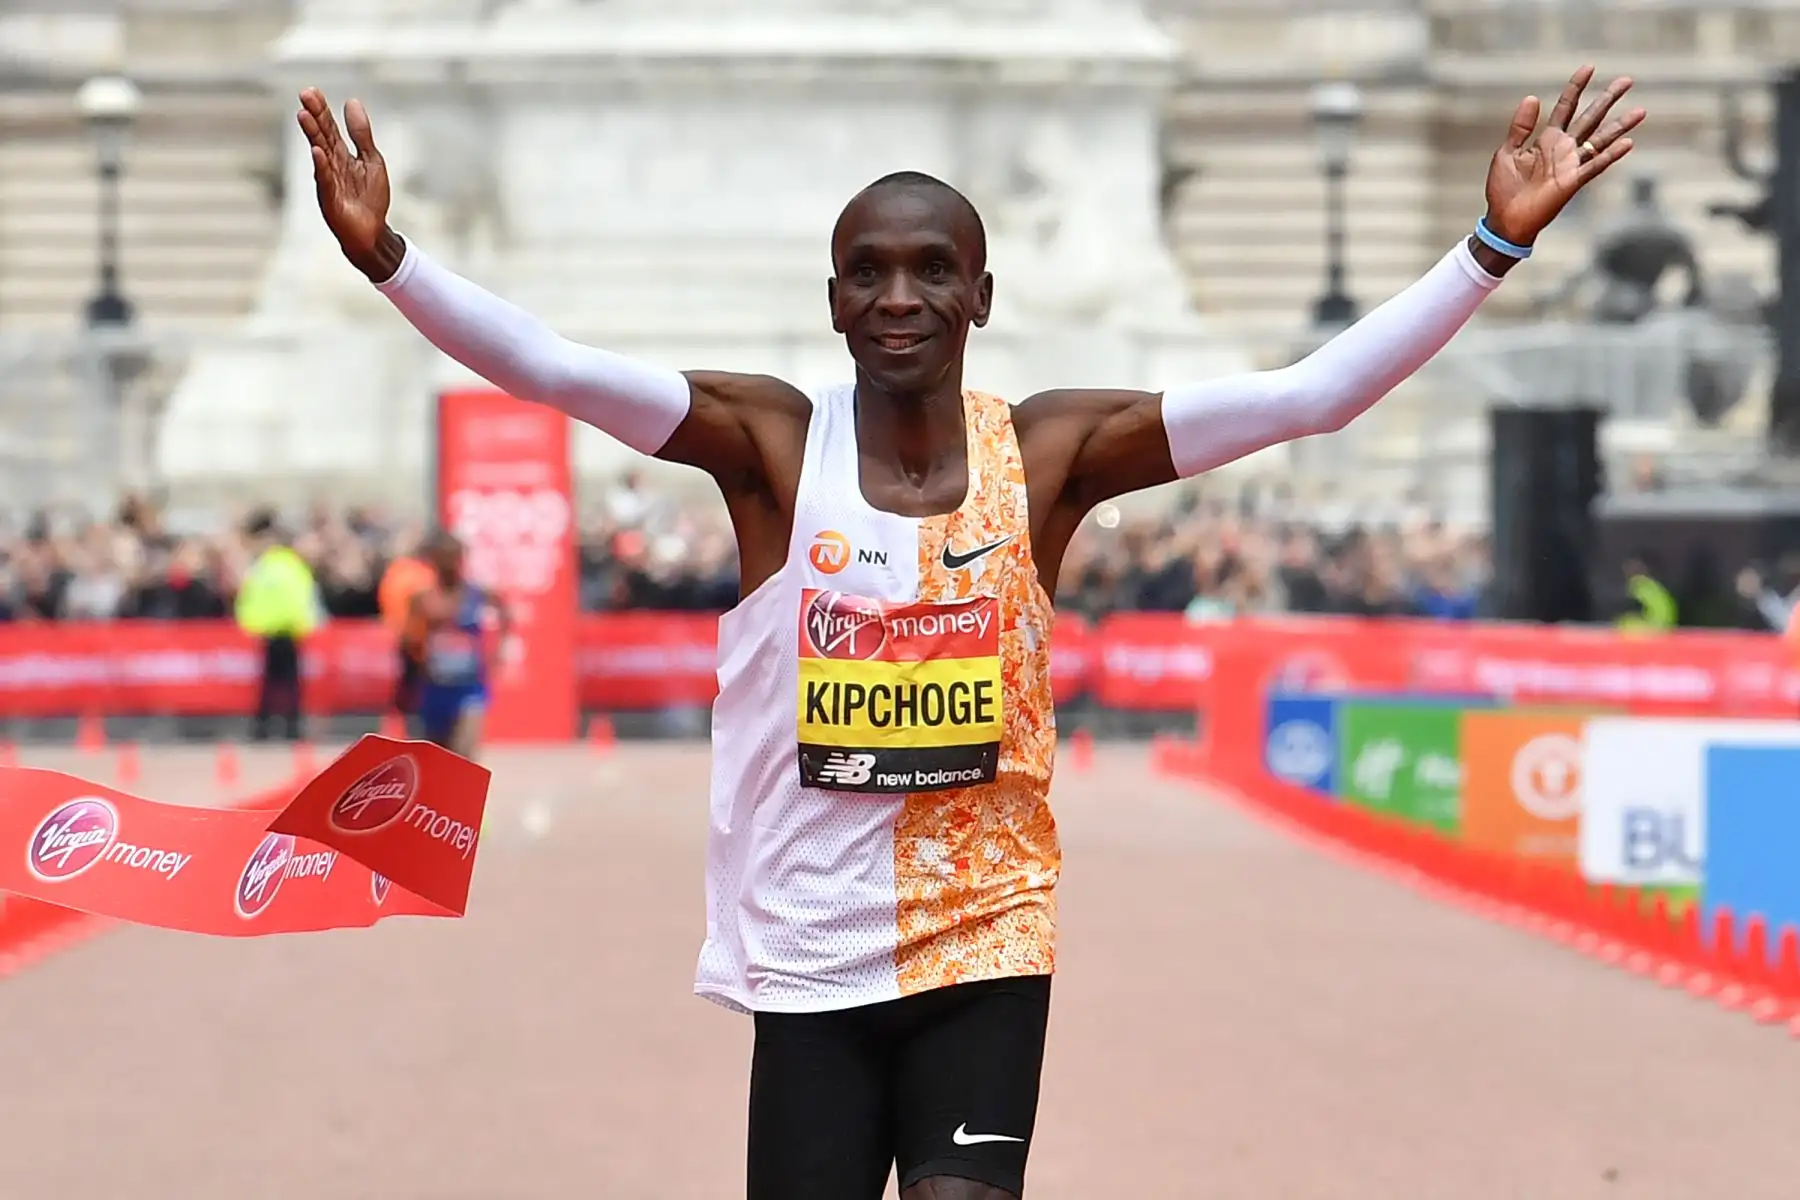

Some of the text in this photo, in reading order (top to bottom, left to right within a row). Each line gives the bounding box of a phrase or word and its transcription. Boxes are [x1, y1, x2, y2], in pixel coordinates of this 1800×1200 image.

[858, 548, 888, 566] NN
[891, 610, 992, 640] money
[805, 679, 995, 728] KIPCHOGE
[876, 772, 914, 787] new
[339, 764, 477, 861] Virgin money
[38, 808, 193, 881] Virgin money
[285, 851, 339, 883] money
